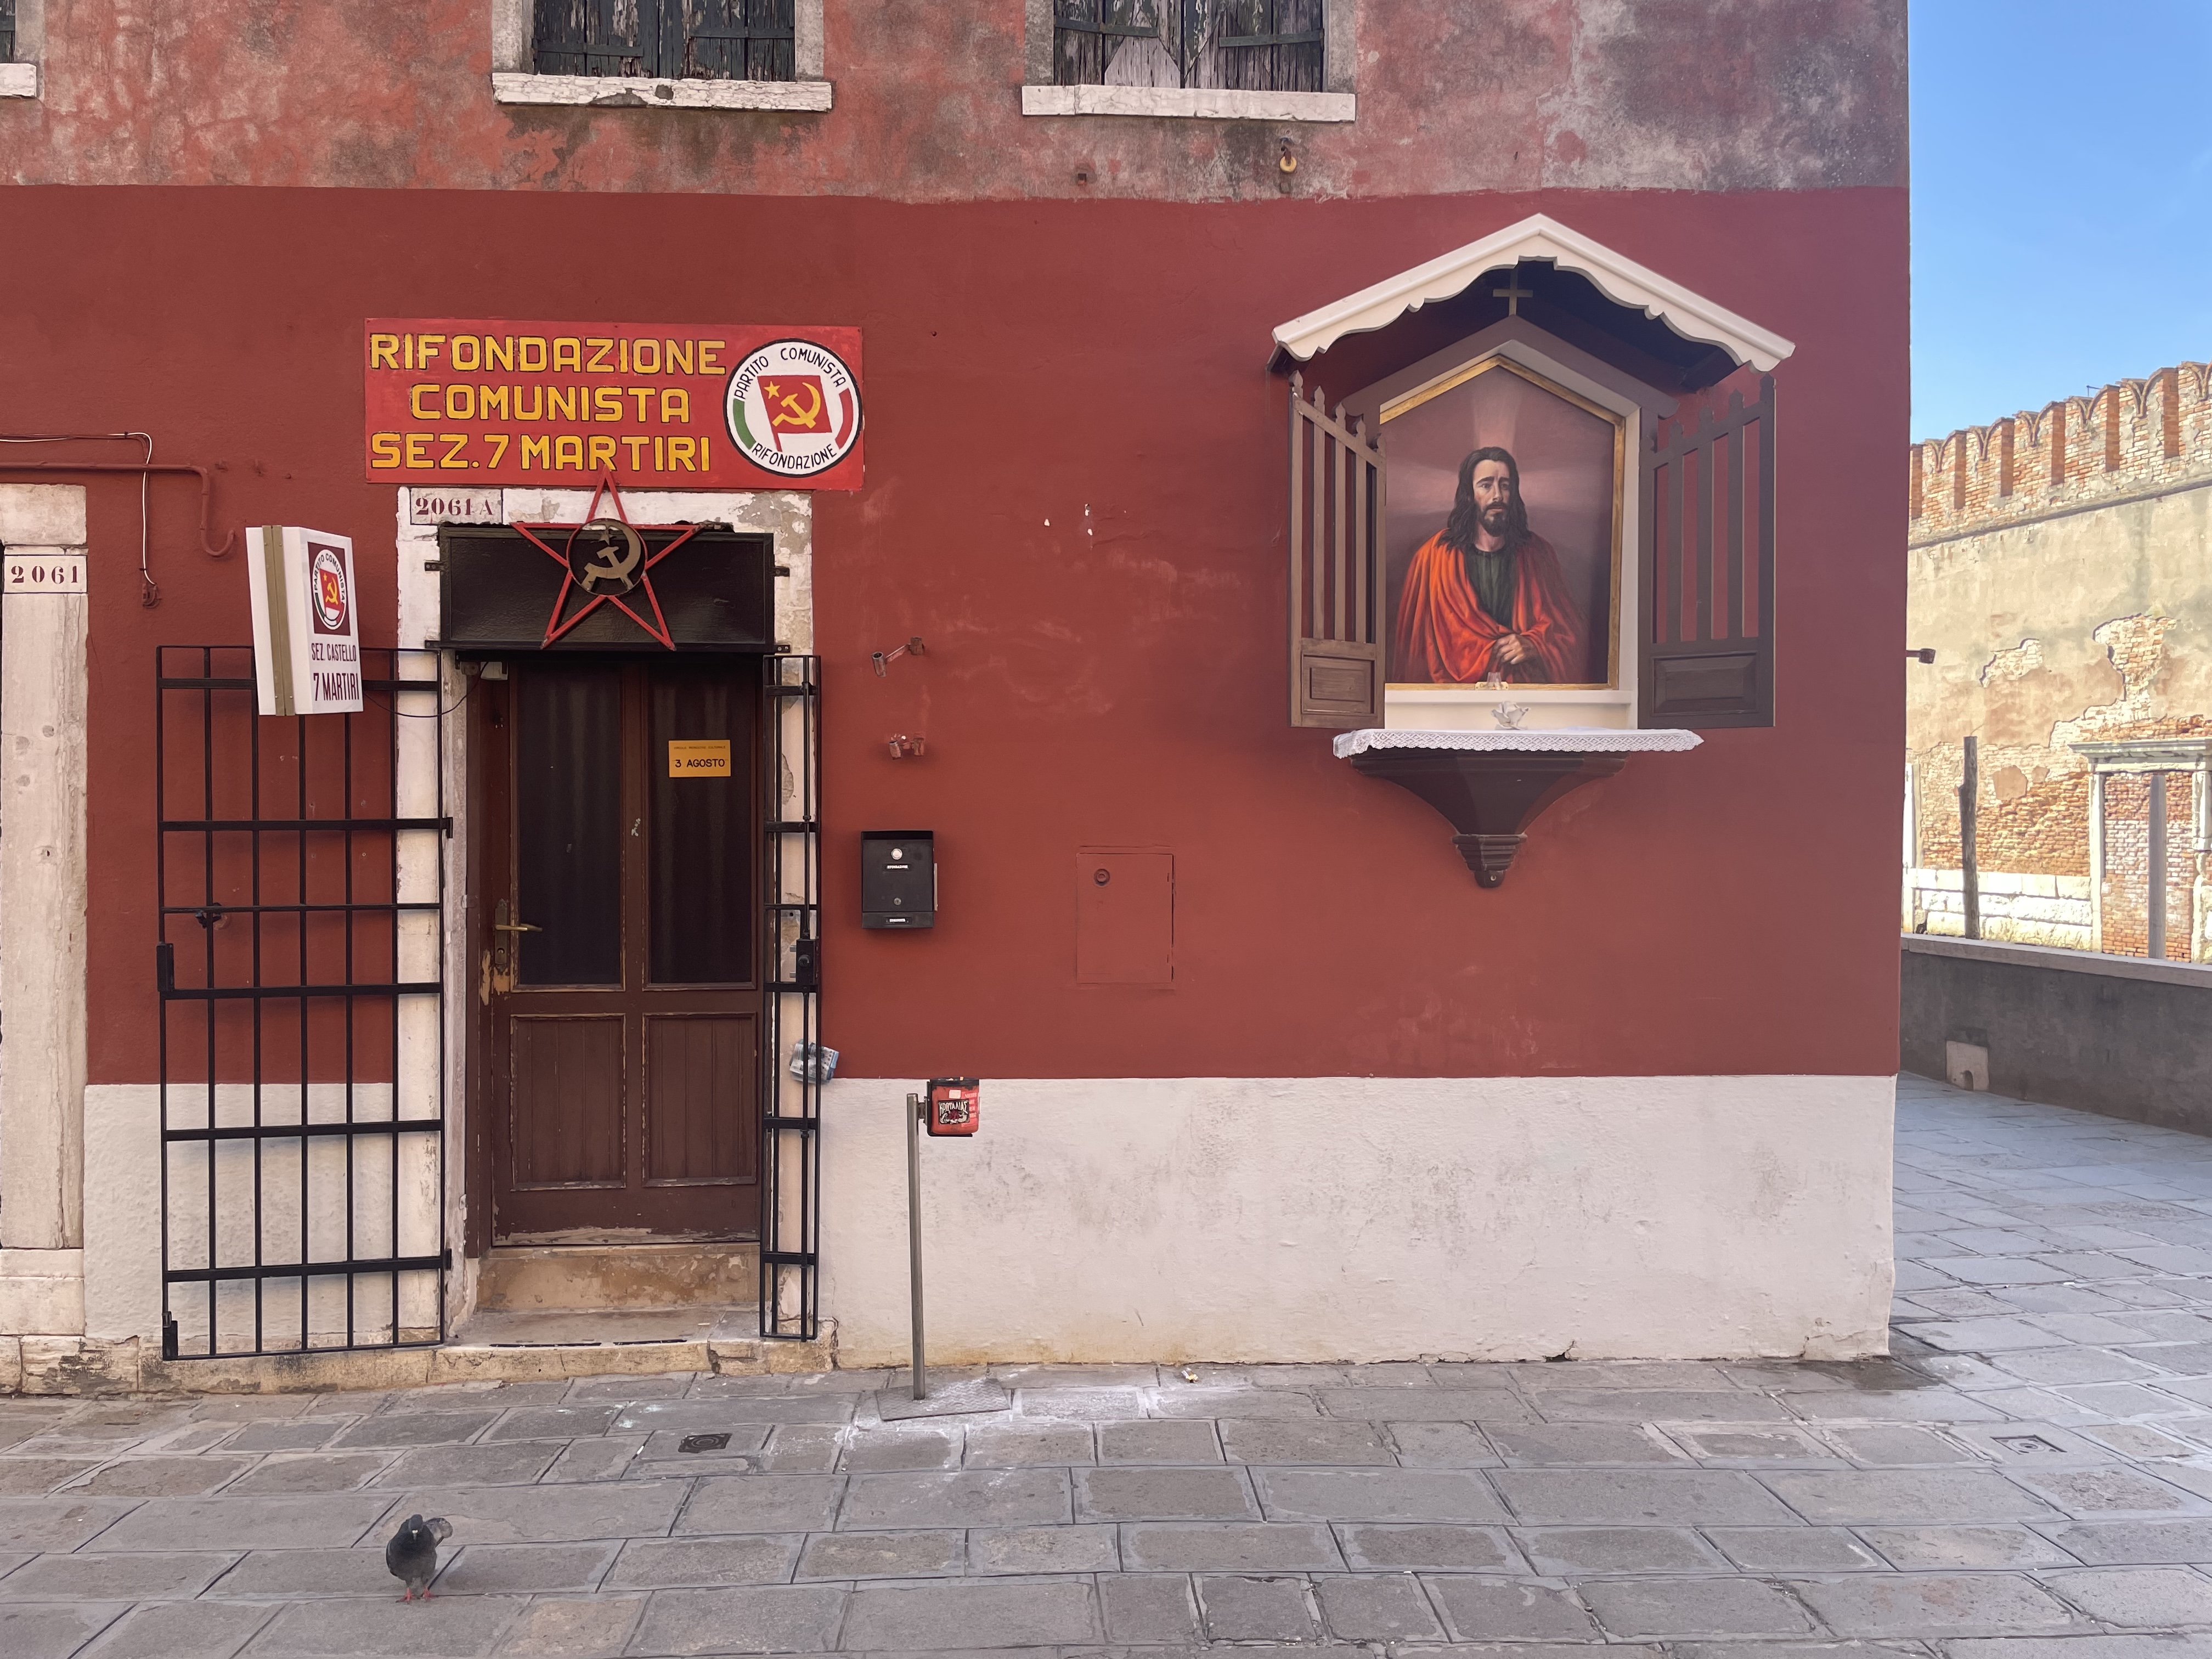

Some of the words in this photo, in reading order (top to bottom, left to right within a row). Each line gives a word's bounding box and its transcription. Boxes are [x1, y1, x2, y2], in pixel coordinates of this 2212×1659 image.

[369, 333, 727, 375] RIFONDAZIONE
[733, 356, 769, 399] PARTITO
[780, 347, 847, 388] COMUNISTA
[410, 383, 691, 424] COMUNISTA
[520, 435, 710, 471] MARTIRI
[752, 443, 837, 470] RIFONDAZIONE
[11, 565, 78, 584] 2061
[311, 642, 325, 661] SEZ.
[326, 644, 357, 662] CASTELLO
[313, 673, 319, 701] 7
[322, 673, 359, 701] MARTIRI
[675, 759, 681, 768] 3
[687, 759, 725, 768] AGOSTO
